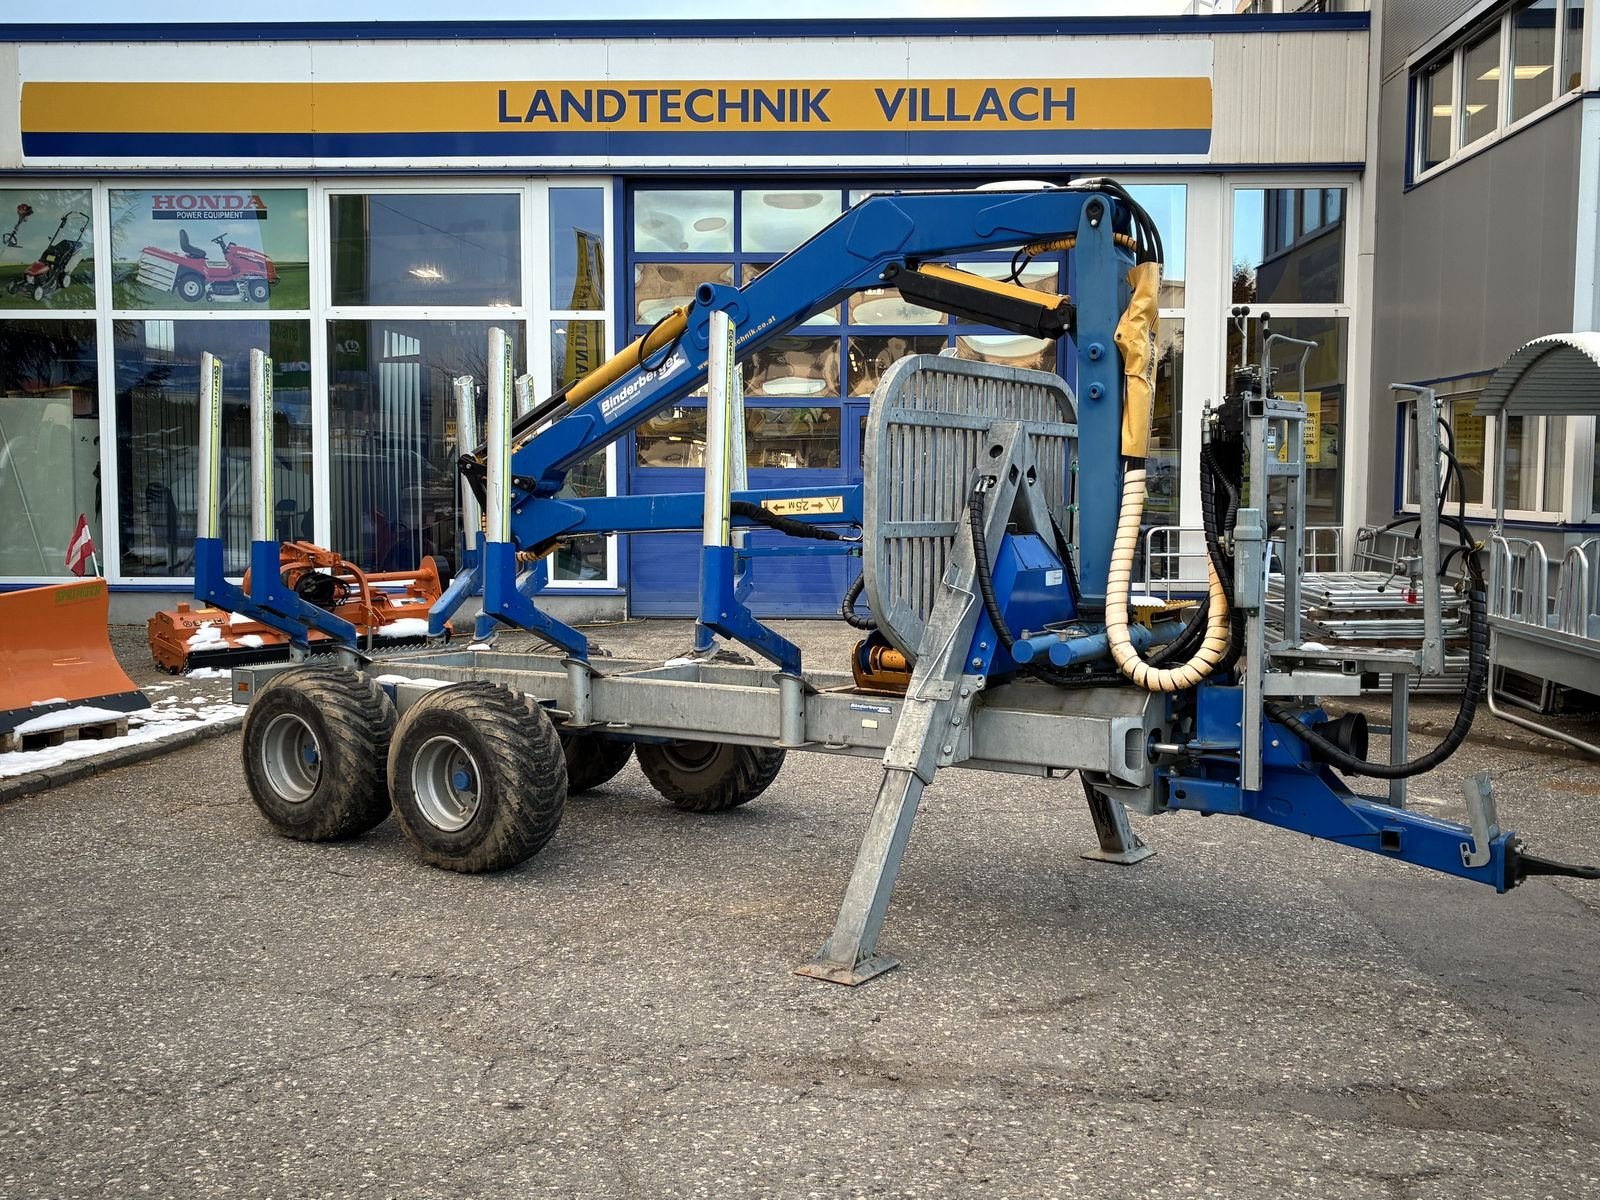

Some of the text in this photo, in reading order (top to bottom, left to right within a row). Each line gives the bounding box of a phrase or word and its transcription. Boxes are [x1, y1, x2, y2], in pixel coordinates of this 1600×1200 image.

[498, 87, 1076, 123] LANDTECHNIK VILLACH
[152, 195, 267, 210] HONDA
[176, 211, 243, 219] POWER EQUIPMENT
